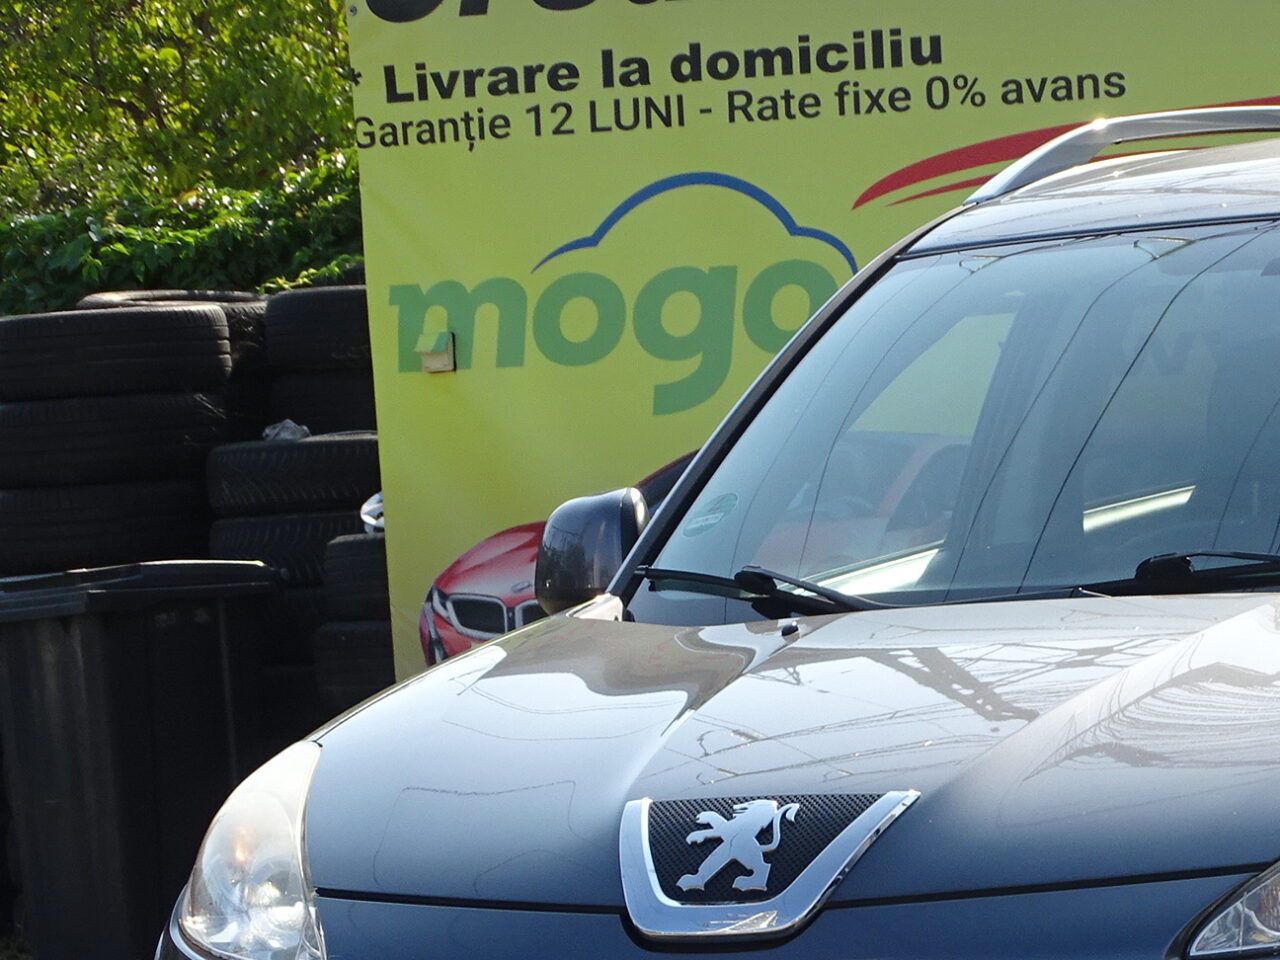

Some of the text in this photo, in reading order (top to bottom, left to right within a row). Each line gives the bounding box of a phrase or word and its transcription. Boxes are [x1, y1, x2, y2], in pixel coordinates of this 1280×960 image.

[383, 28, 943, 104] Livrare la domiciliu
[355, 107, 512, 153] Garanție
[525, 102, 575, 137] 12
[589, 94, 685, 133] LUNI
[727, 88, 822, 124] Rate
[834, 80, 912, 117] fixe
[925, 74, 987, 110] 0%
[1000, 71, 1127, 105] avans
[388, 259, 839, 416] mogo
